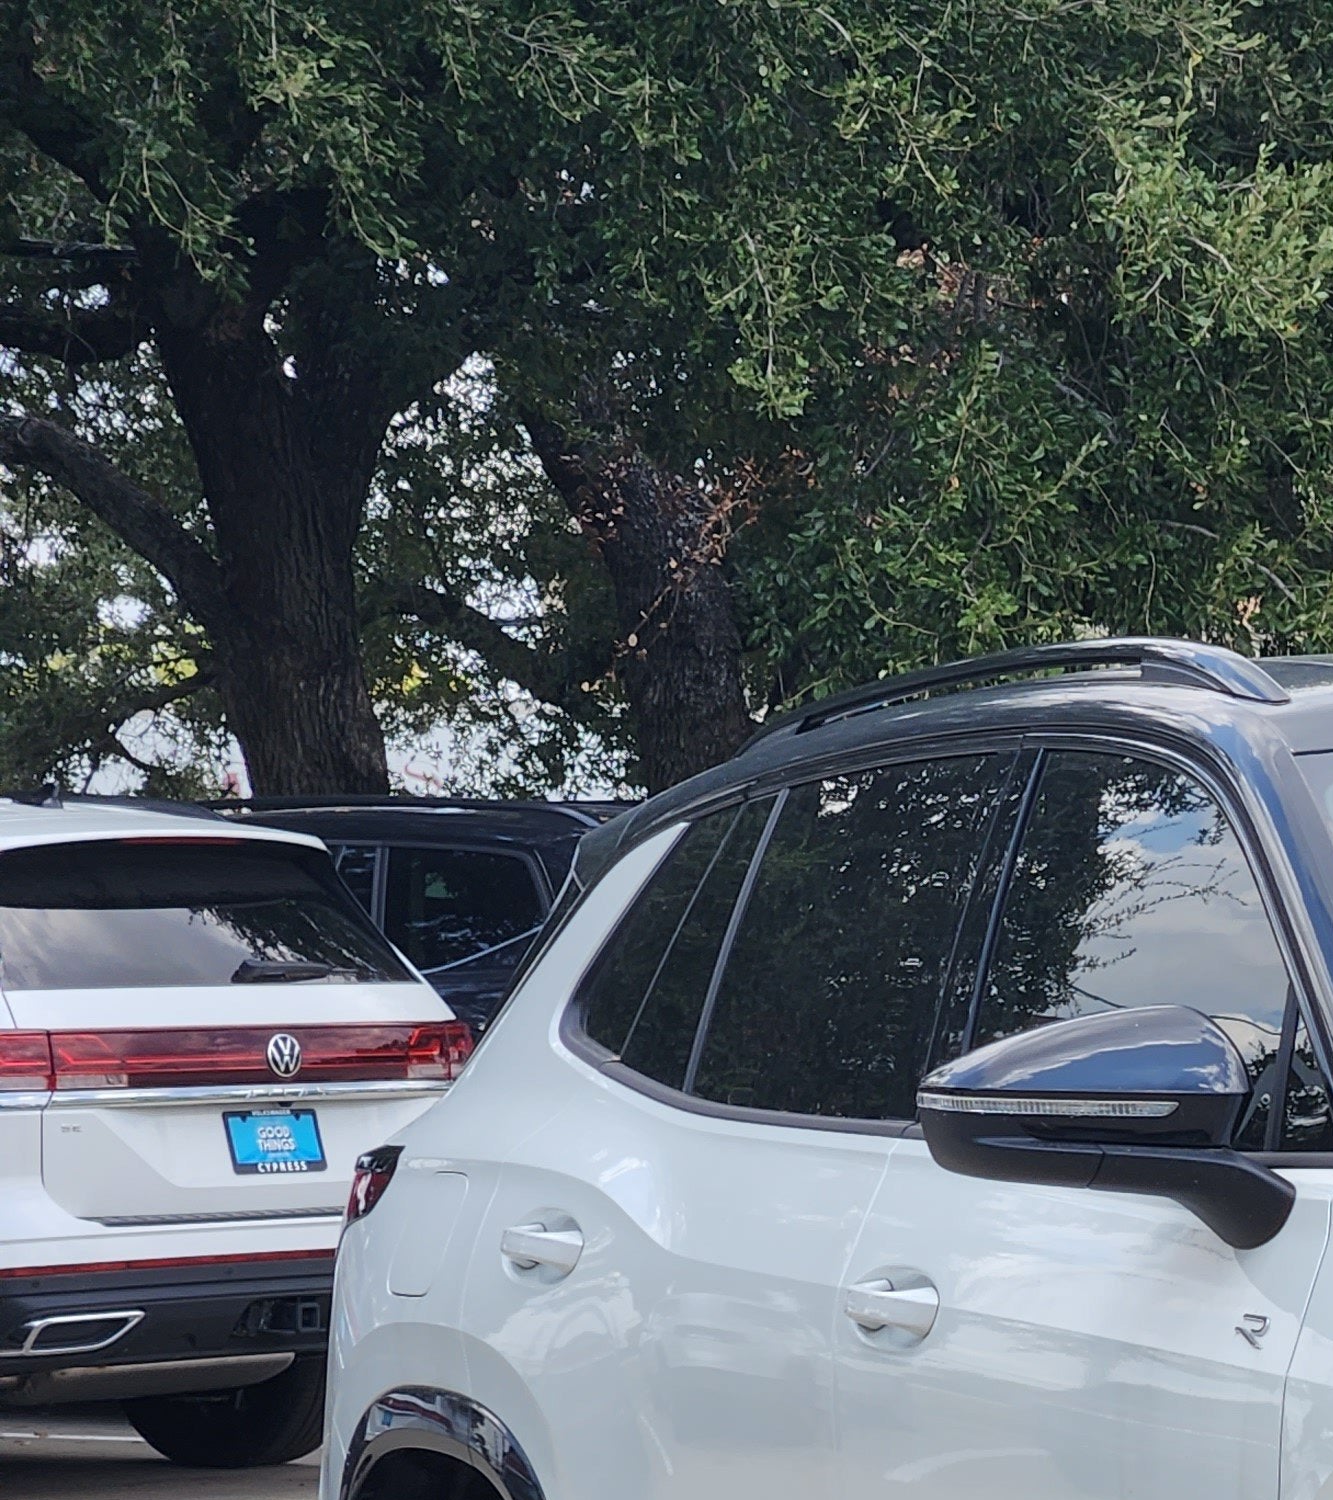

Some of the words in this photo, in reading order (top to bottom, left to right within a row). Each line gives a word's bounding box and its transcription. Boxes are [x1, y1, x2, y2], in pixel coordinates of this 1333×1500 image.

[257, 1126, 290, 1139] GOOD
[257, 1139, 297, 1152] THINGS
[257, 1161, 308, 1173] CYPRESS
